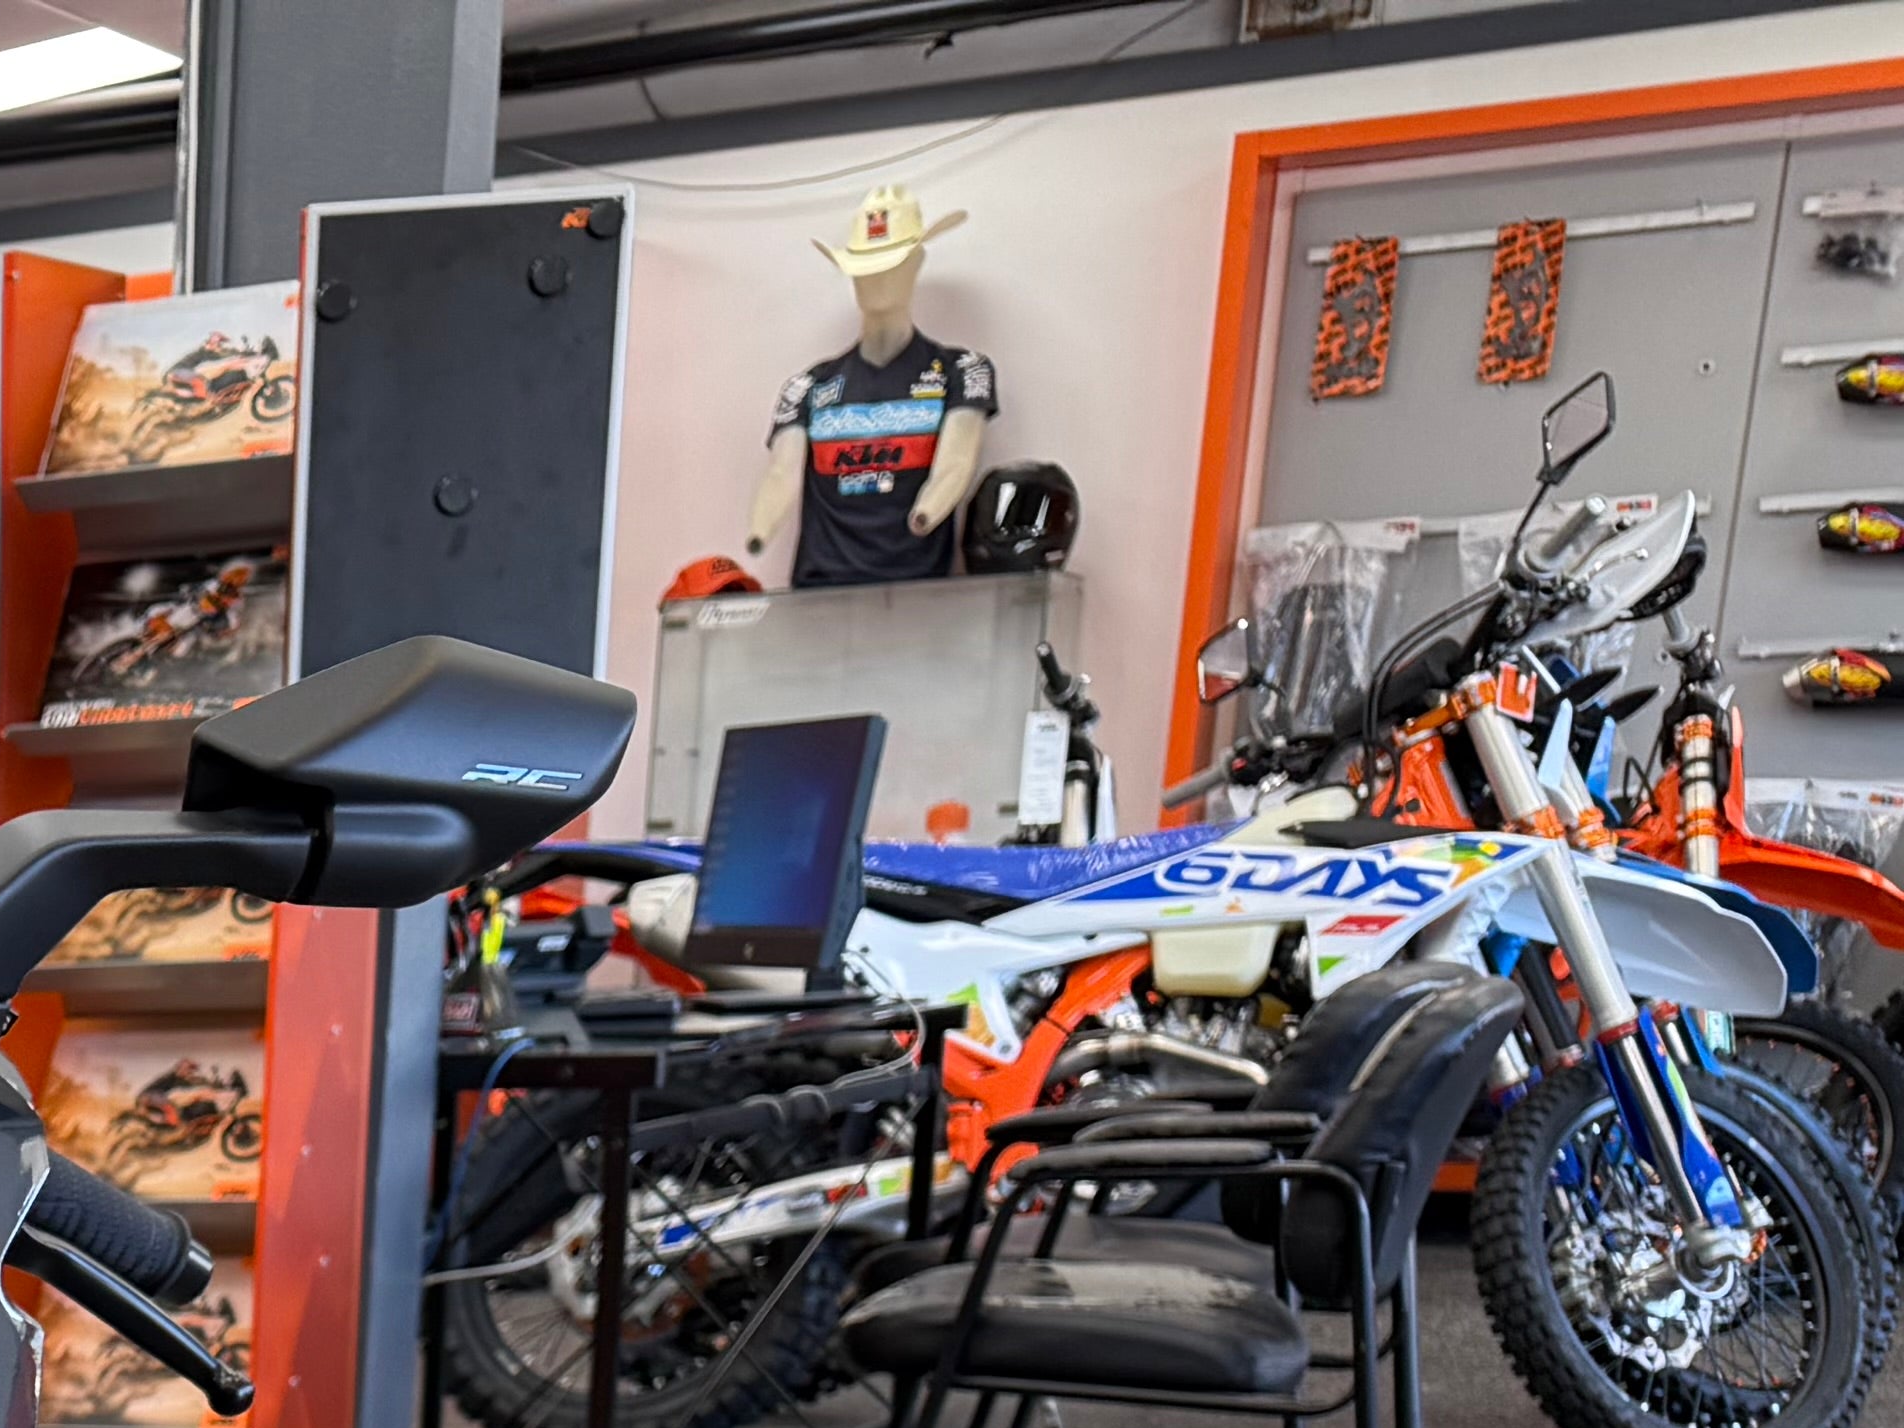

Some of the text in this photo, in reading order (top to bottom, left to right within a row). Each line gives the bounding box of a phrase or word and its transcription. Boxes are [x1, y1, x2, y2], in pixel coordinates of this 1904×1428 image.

[835, 445, 906, 468] KTM
[462, 763, 583, 790] RC
[1162, 848, 1455, 908] 6DAYS
